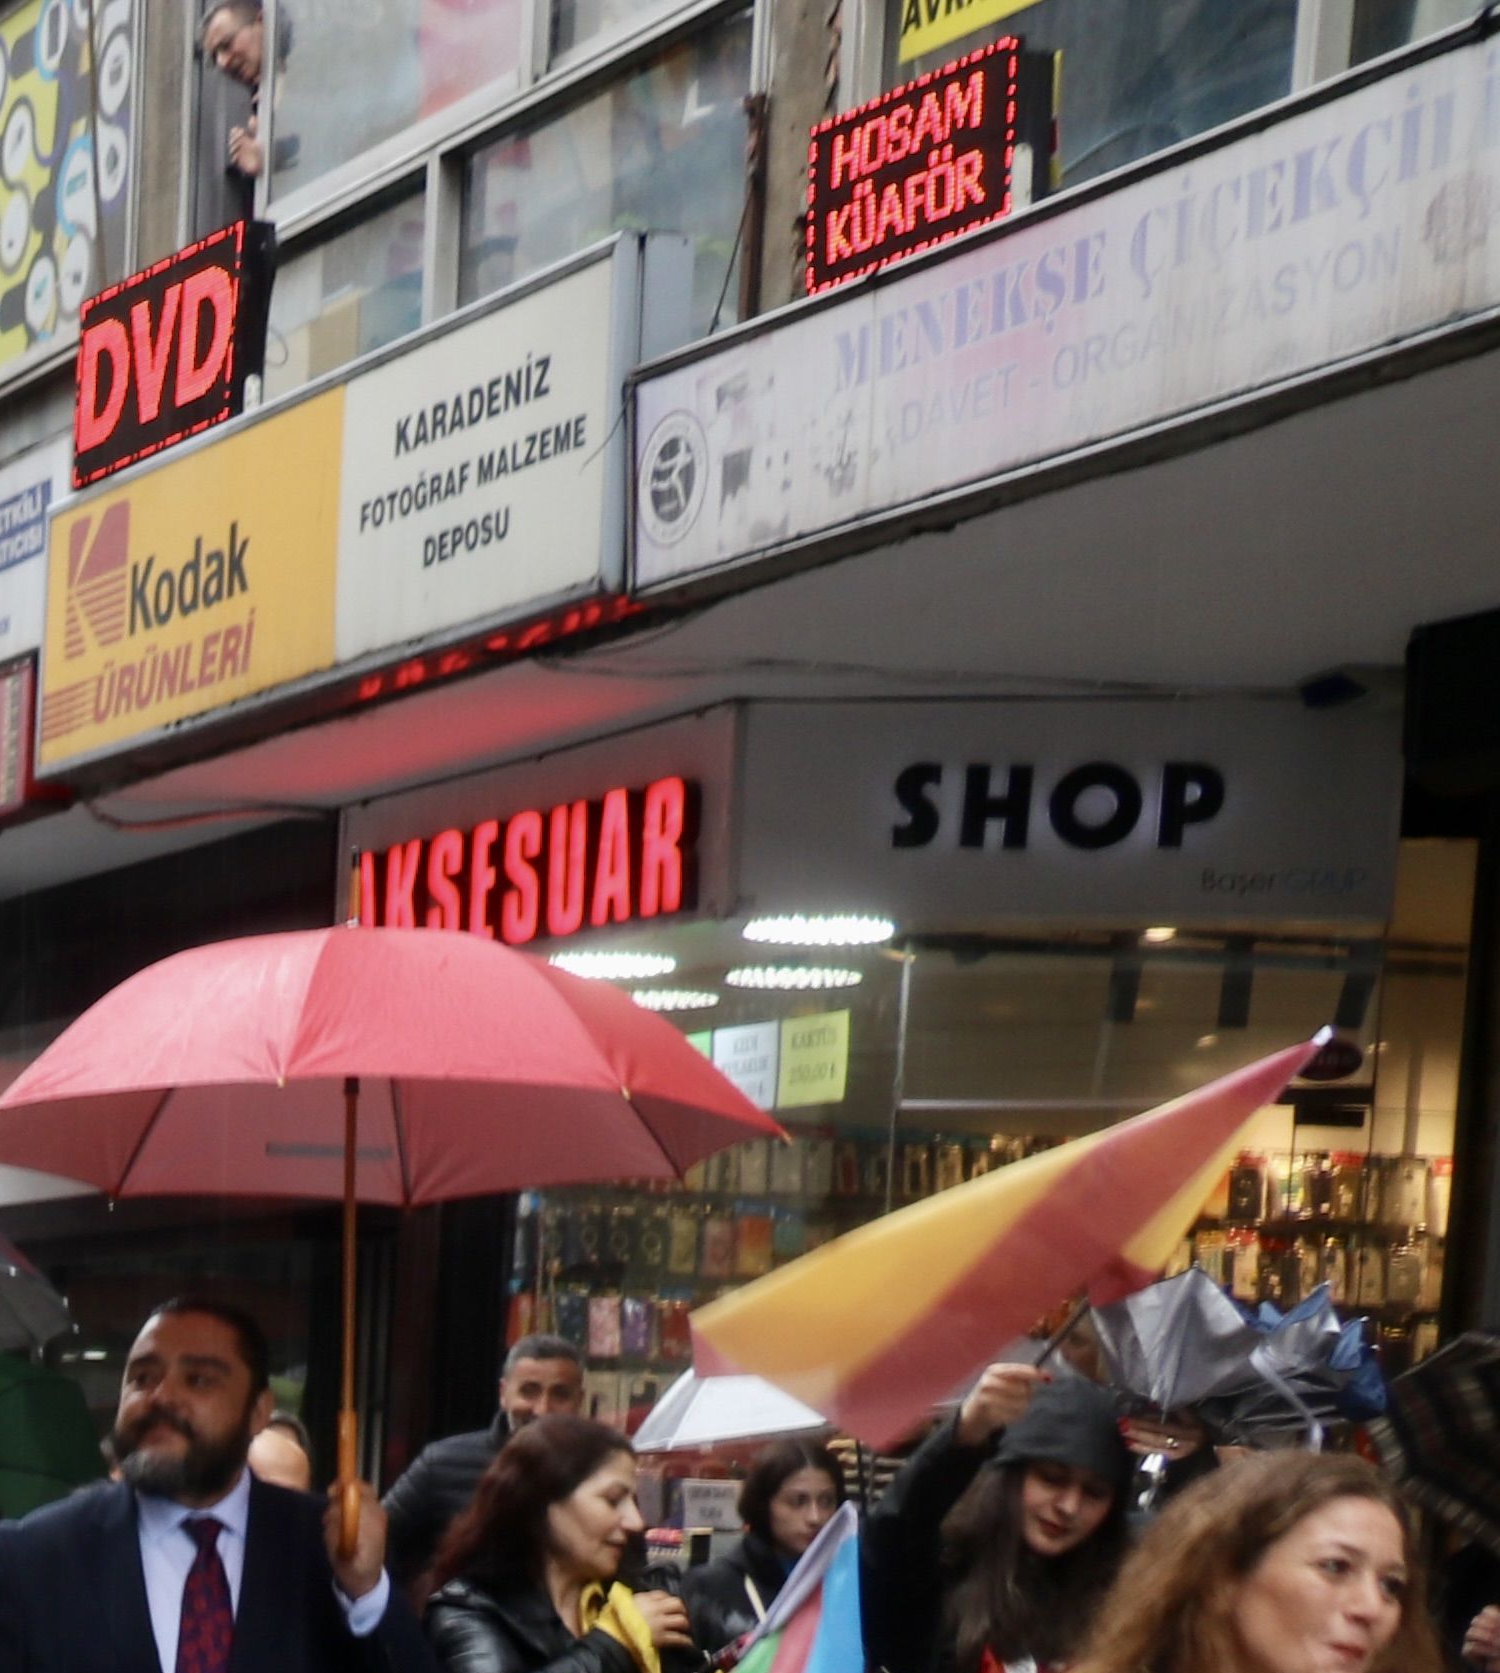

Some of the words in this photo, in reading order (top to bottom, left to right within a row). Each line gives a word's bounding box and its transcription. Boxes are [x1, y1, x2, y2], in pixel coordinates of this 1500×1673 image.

[831, 70, 985, 190] HOSAM
[826, 145, 986, 266] KÜAFÖR
[77, 264, 235, 453] DVD
[833, 232, 1107, 393] MENEKŞE
[394, 351, 553, 459] KARADENİZ
[360, 459, 471, 534] FOTOĞRAF
[476, 413, 587, 487] MALZEME
[129, 520, 250, 637] Kodak
[422, 505, 511, 569] DEPOSU
[93, 606, 256, 724] ÜRÜNLERİ
[891, 760, 1226, 850] SHOP
